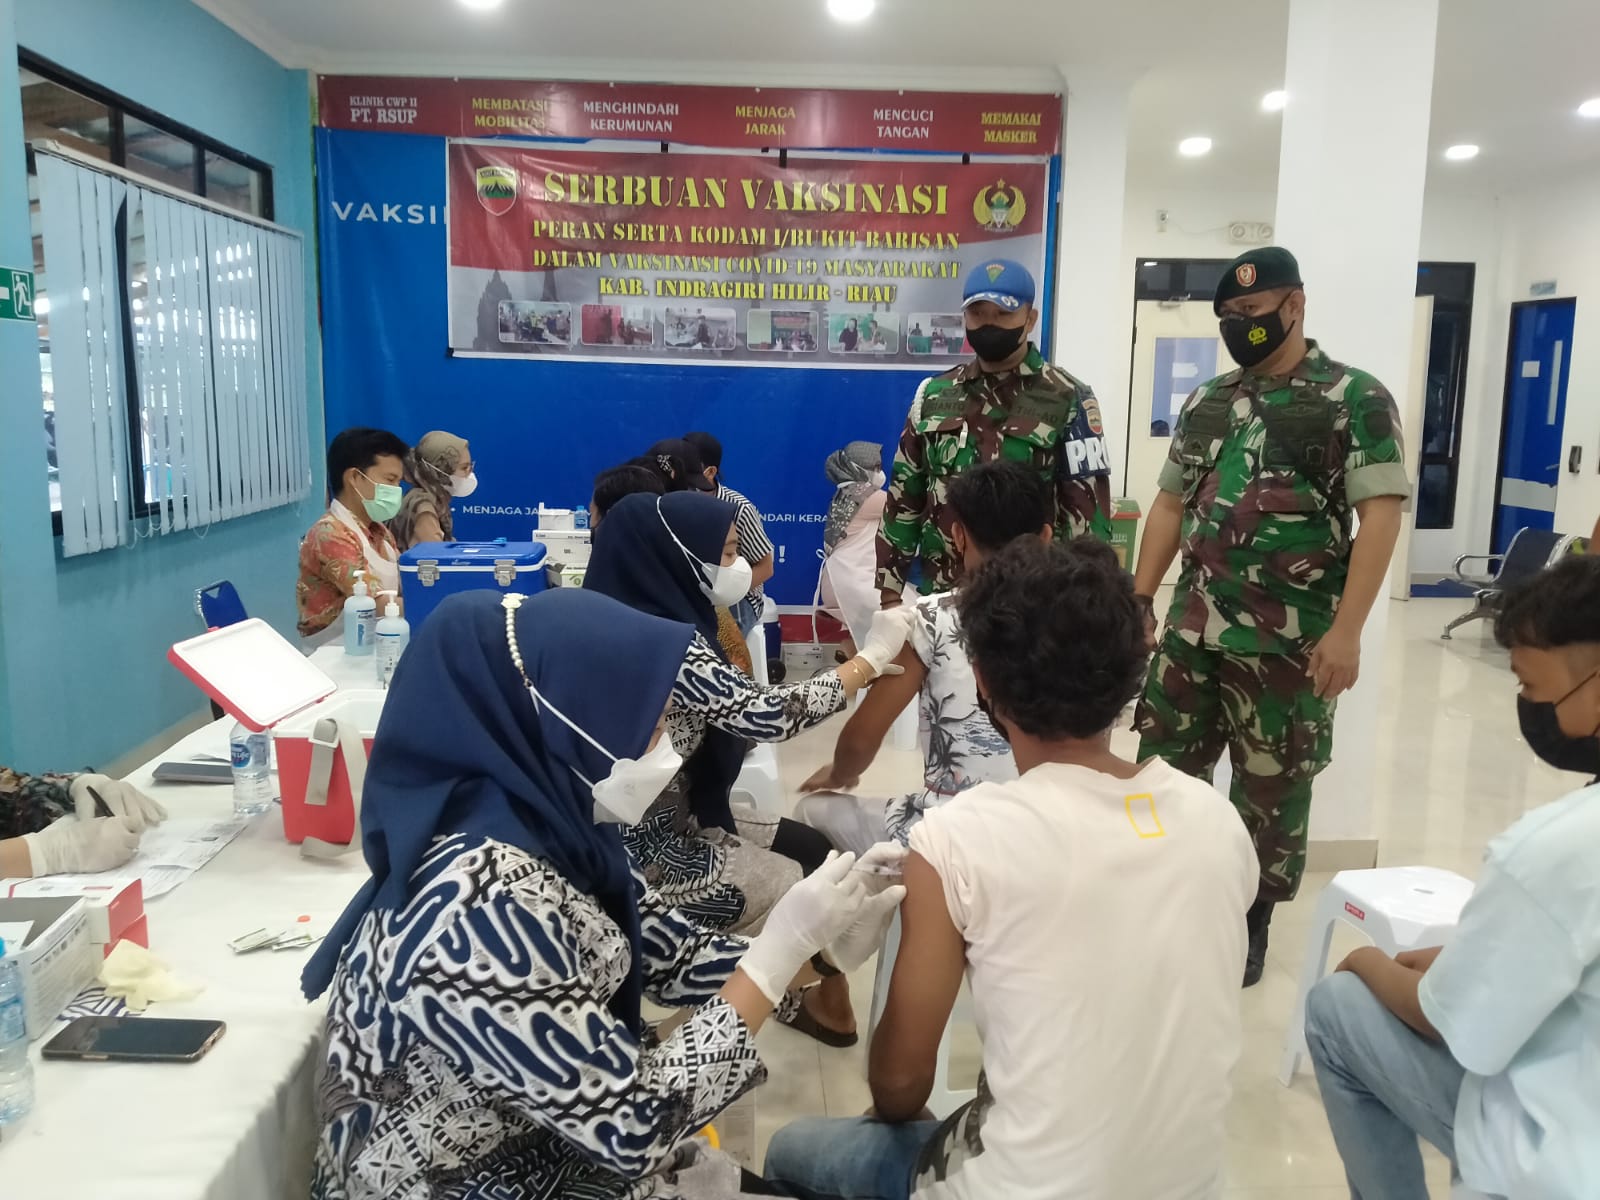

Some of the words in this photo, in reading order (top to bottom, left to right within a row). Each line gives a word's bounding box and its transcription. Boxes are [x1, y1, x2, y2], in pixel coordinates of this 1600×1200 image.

[349, 96, 384, 106] KLINIK
[386, 97, 407, 107] CWP
[472, 98, 549, 112] MEMBATASI
[583, 102, 679, 115] MENGHINDARI
[735, 106, 796, 119] MENJAGA
[350, 108, 371, 123] PT.
[377, 108, 417, 124] RSUP
[475, 115, 545, 128] MOBILITAS
[873, 109, 934, 122] MENCUCI
[981, 112, 1041, 126] MEMAKAI
[590, 119, 673, 132] KERUMUNAN
[745, 123, 785, 135] JARAK
[877, 126, 929, 138] TANGAN
[984, 130, 1037, 143] MASKER
[544, 172, 727, 208] SERBUAN
[740, 178, 948, 215] VAKSINASI
[533, 220, 606, 240] PERAN
[613, 223, 683, 242] SERTA
[690, 226, 766, 245] KODAM
[774, 228, 859, 248] I/BUKIT
[866, 231, 959, 249] BARISAN
[533, 249, 601, 268] DALAM
[608, 252, 720, 272] VAKSINASI
[725, 257, 818, 275] COVID-19
[824, 259, 961, 278] MASYARAKAT
[599, 277, 649, 295] KAB.
[656, 279, 765, 299] INDRAGIRI
[772, 282, 830, 300] HILIR
[847, 285, 897, 303] RIAU
[462, 505, 522, 515] MENJAGA
